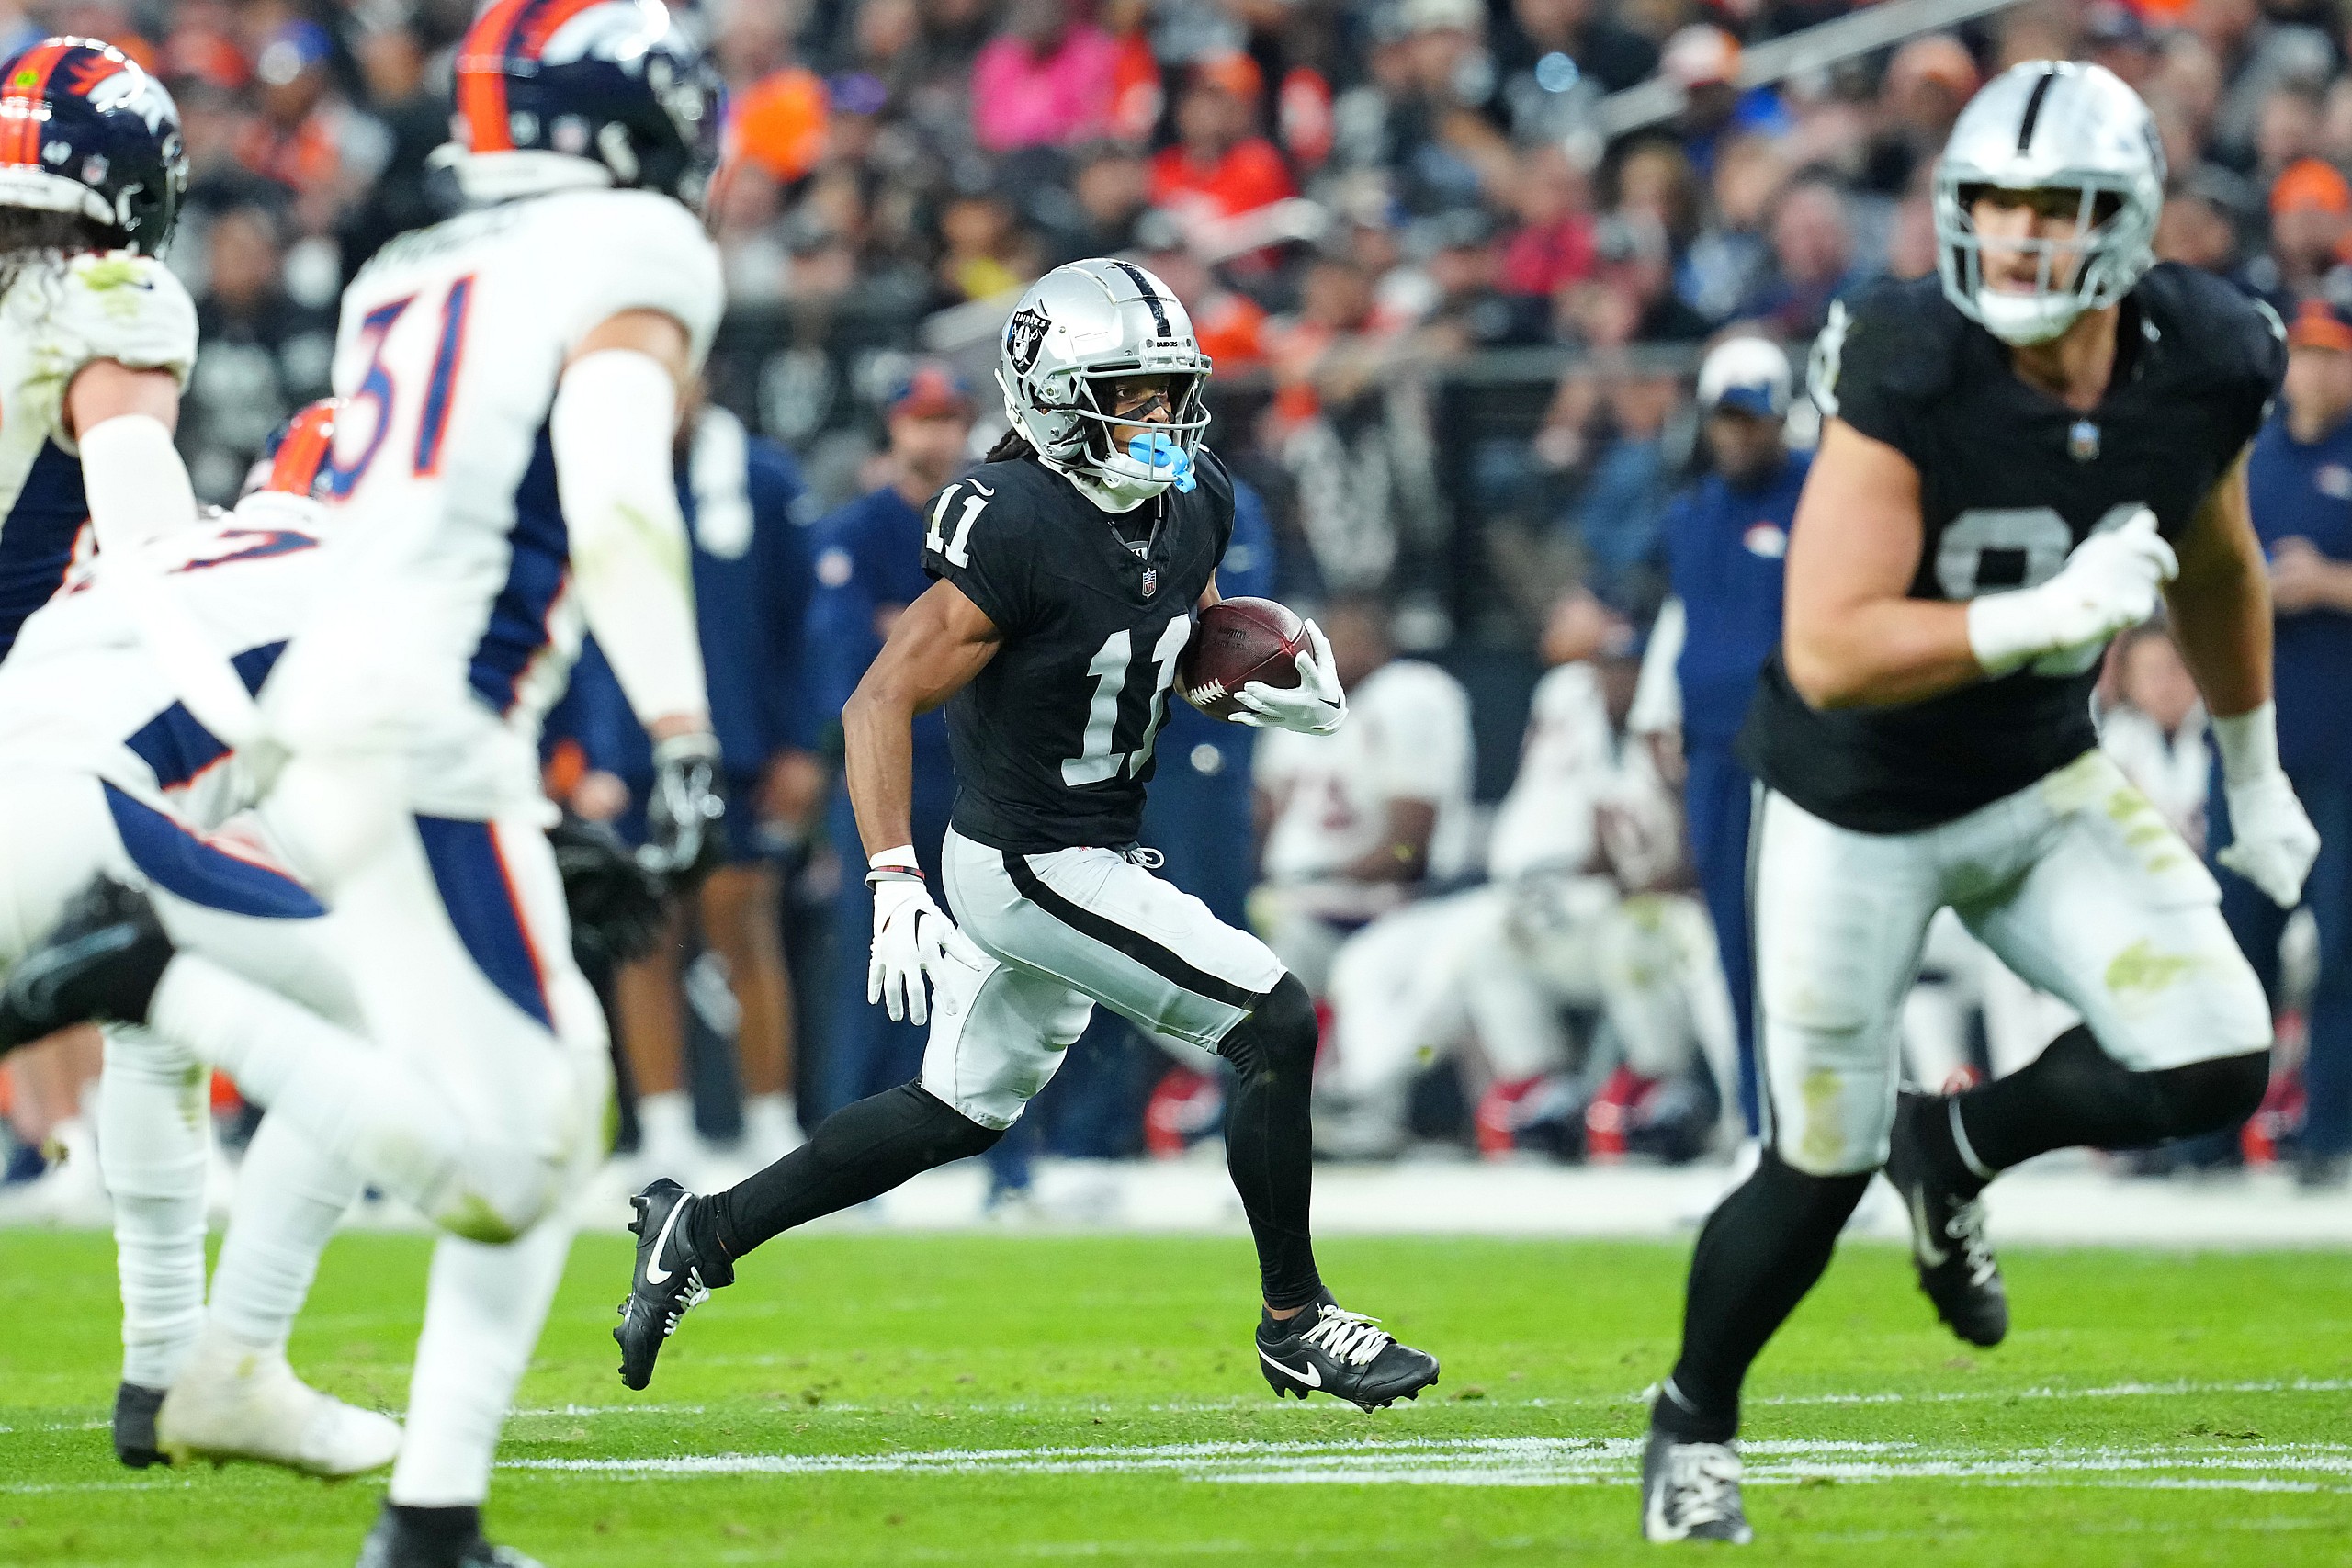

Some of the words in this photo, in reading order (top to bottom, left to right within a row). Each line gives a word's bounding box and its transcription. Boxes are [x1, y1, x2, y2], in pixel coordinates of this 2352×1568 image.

[1014, 312, 1047, 328] RAIDERS
[317, 271, 476, 502] 31
[925, 483, 989, 569] 11
[1060, 613, 1192, 787] 11
